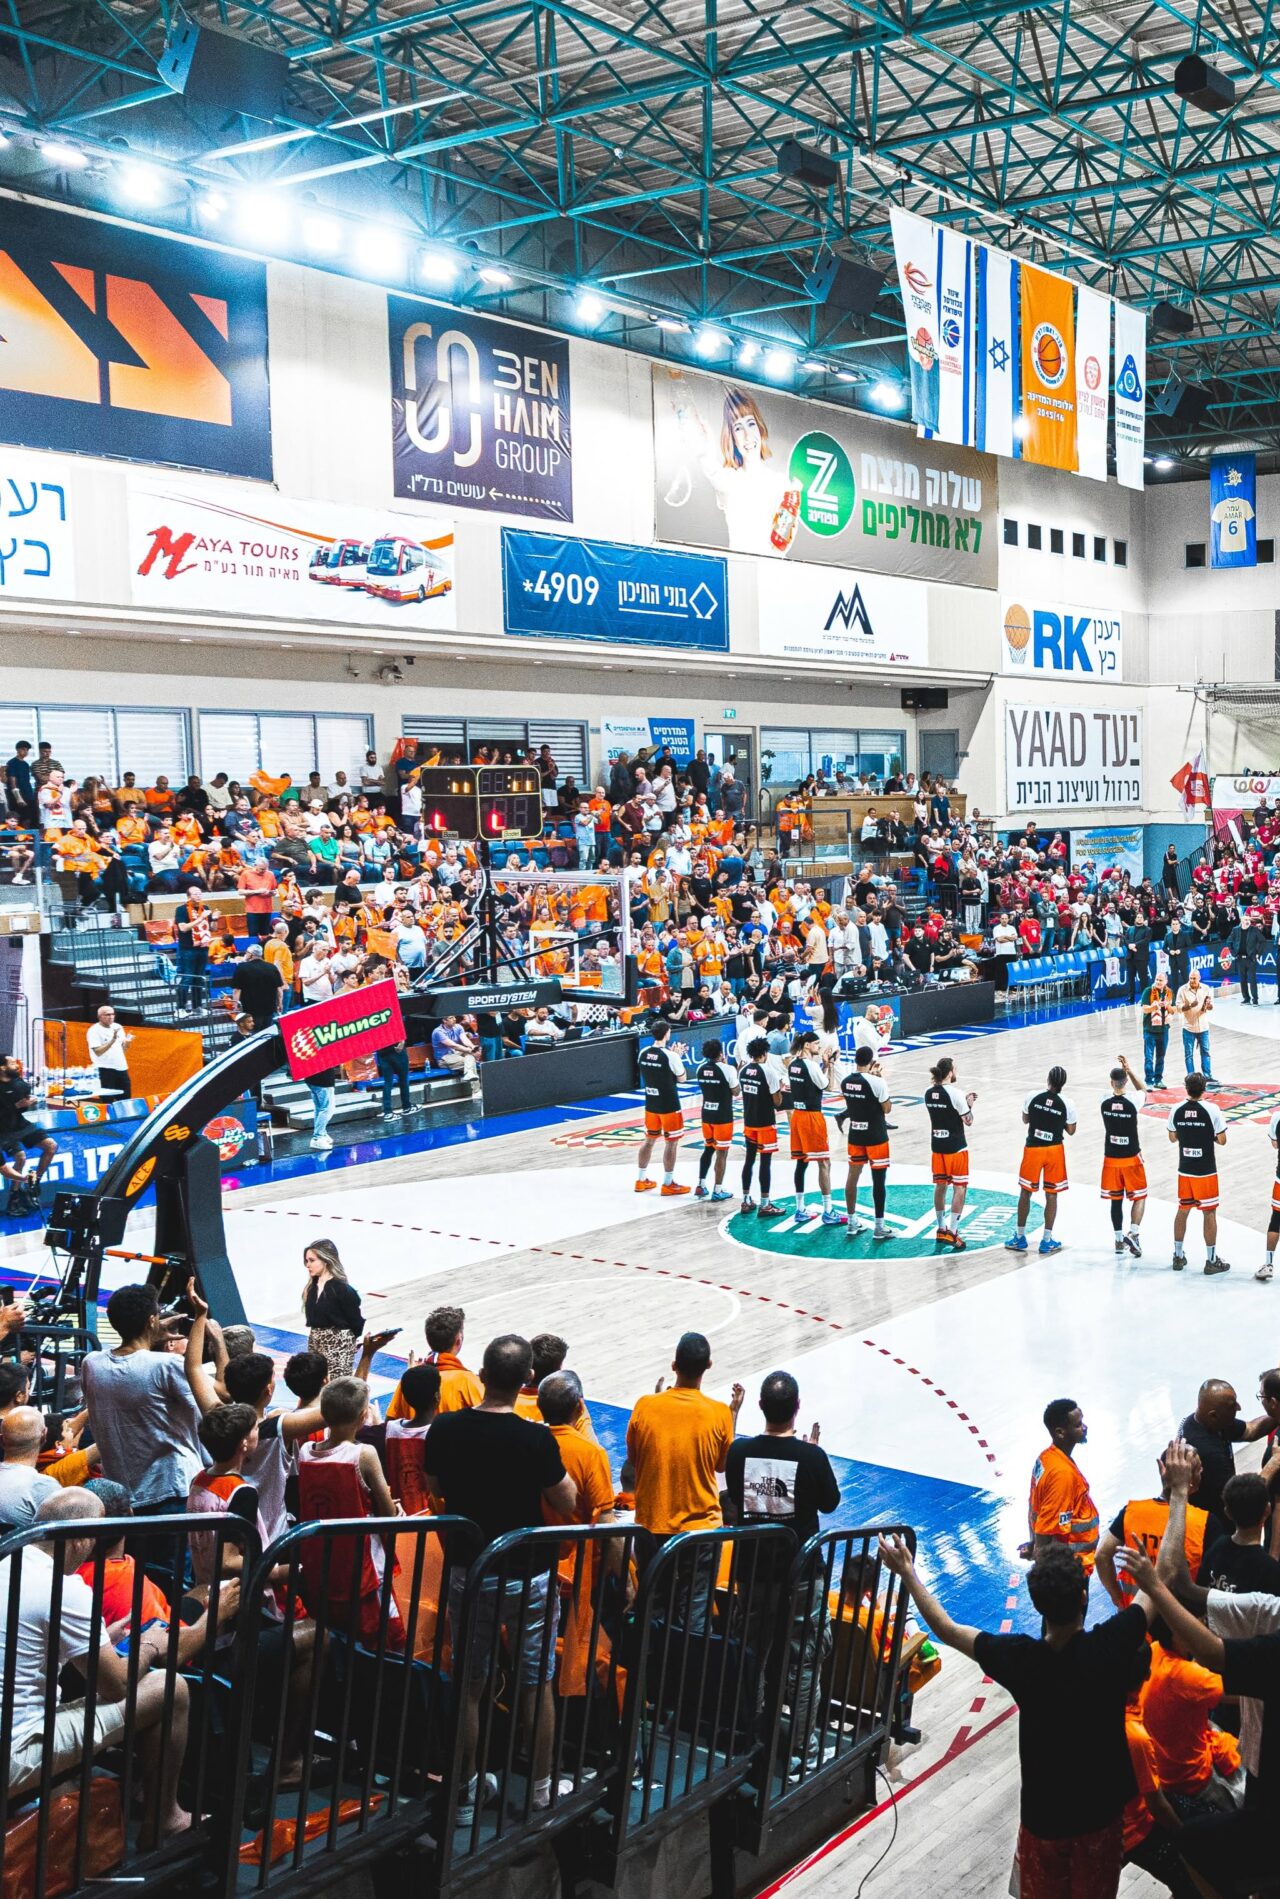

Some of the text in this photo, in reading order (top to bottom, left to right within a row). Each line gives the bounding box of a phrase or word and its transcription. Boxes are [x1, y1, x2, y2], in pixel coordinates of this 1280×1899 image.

[493, 348, 559, 400] BEN
[495, 438, 561, 477] GROUP
[447, 480, 486, 499] עושים
[860, 453, 982, 512] שלוק מנצח
[0, 477, 67, 522] רע
[862, 499, 983, 554] לא מחליפים
[1224, 512, 1243, 520] AMAR
[1228, 521, 1238, 535] 6
[239, 540, 300, 561] TOURS
[243, 564, 265, 578] תור
[269, 566, 300, 581] מאיה
[617, 579, 689, 608] בוני התיכון
[1033, 609, 1094, 672] RK
[1093, 618, 1121, 644] רענן
[1098, 649, 1116, 675] כץ
[669, 746, 690, 755] בעול
[1093, 712, 1139, 768] יעד
[1016, 774, 1140, 804] פרזול ועיצוב הבית
[1189, 953, 1215, 971] מאמן
[467, 990, 537, 1006] SPORTSYSTEM
[313, 1008, 392, 1048] Winner
[1119, 1136, 1129, 1144] RK
[1192, 1149, 1202, 1157] RK
[130, 1163, 152, 1189] ACE
[749, 1482, 775, 1490] NORTH
[761, 1476, 775, 1484] THE
